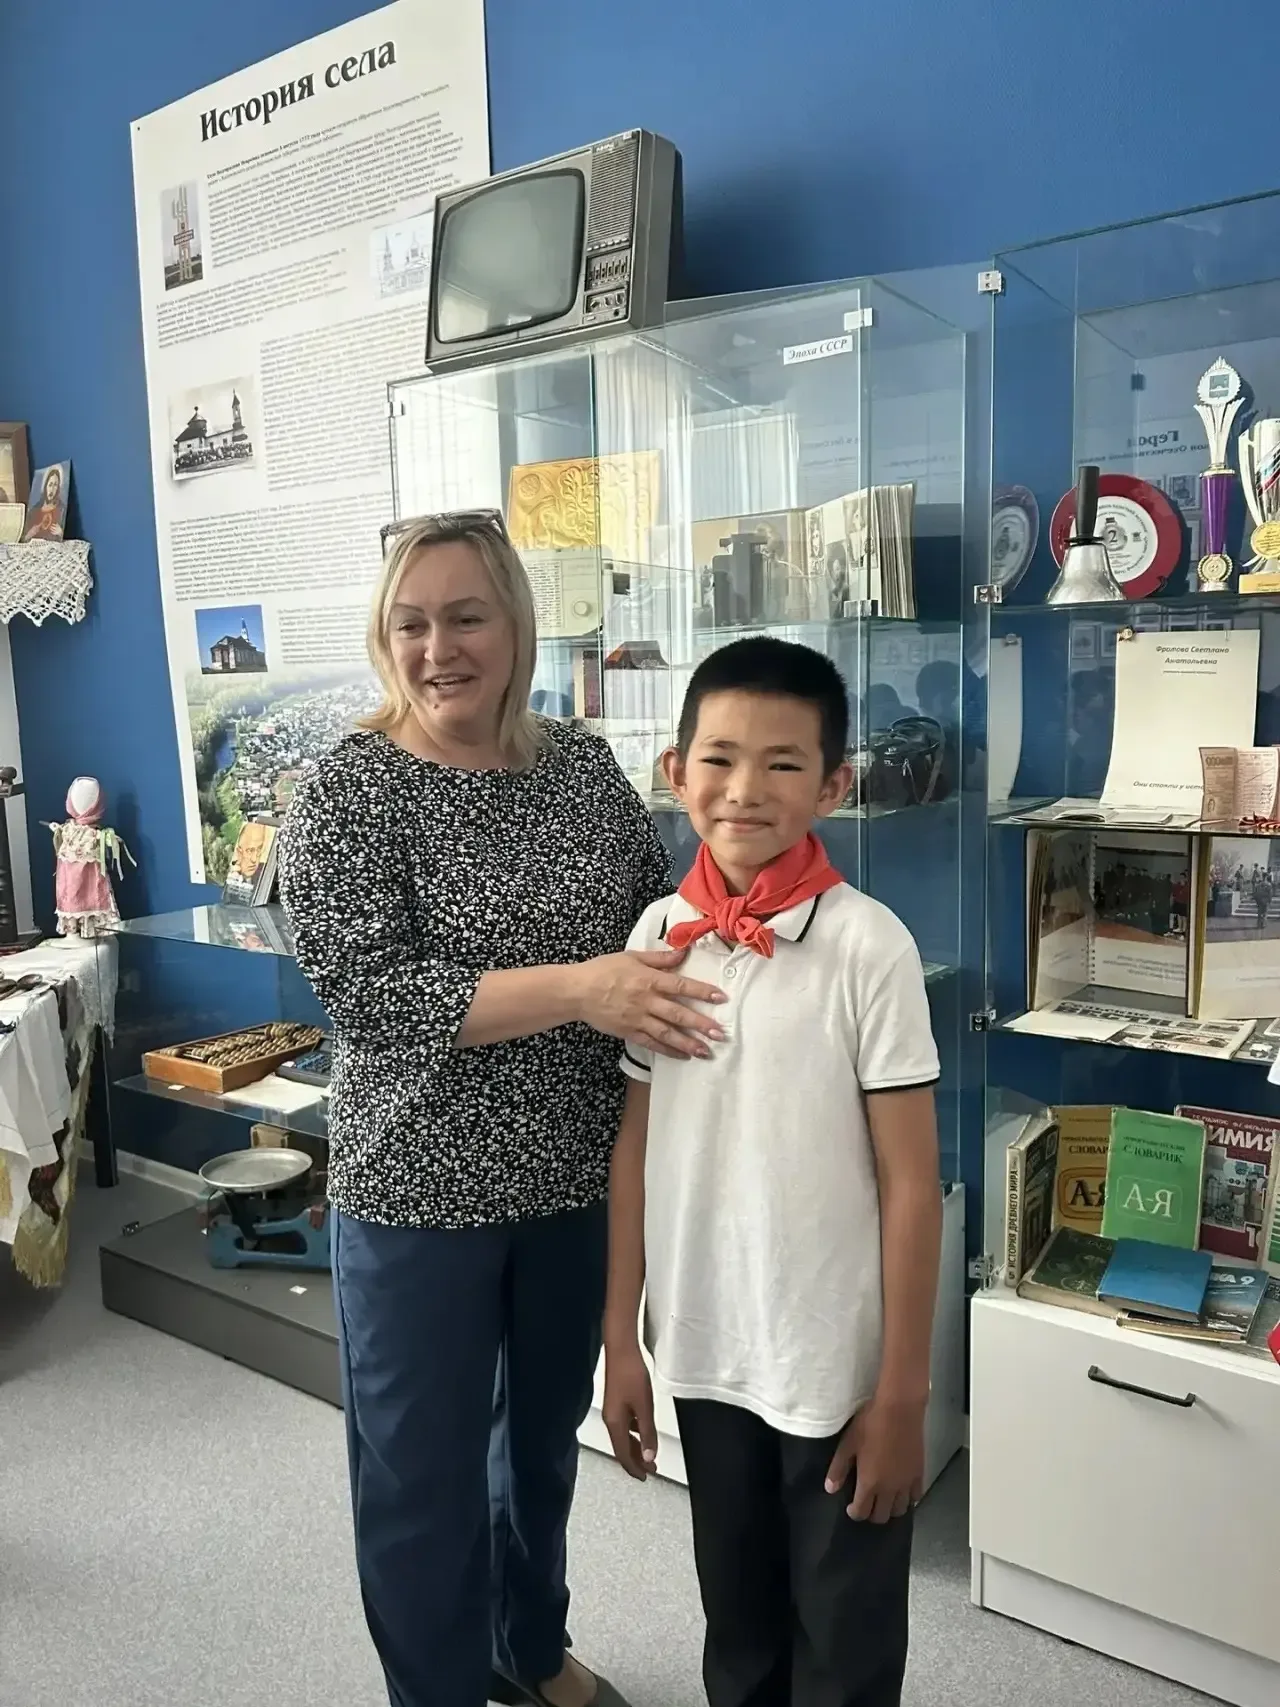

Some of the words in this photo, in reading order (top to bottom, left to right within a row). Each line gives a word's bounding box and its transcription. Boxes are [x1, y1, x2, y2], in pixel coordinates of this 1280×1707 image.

[200, 73, 315, 143] История
[324, 40, 397, 89] села
[788, 347, 817, 360] Эпоха
[819, 339, 848, 353] СССР
[1107, 529, 1117, 543] 2
[1133, 780, 1148, 788] Они
[1207, 1125, 1274, 1152] ИМИЯ
[1123, 1144, 1185, 1164] СЛОВАРИК
[1009, 1169, 1019, 1192] МИРА
[1122, 1183, 1174, 1218] А-Я
[1008, 1193, 1019, 1232] ДРЕВНЕГО
[1246, 1226, 1257, 1248] 1
[1007, 1234, 1017, 1268] ИСТОРИЯ
[1240, 1275, 1256, 1286] 9
